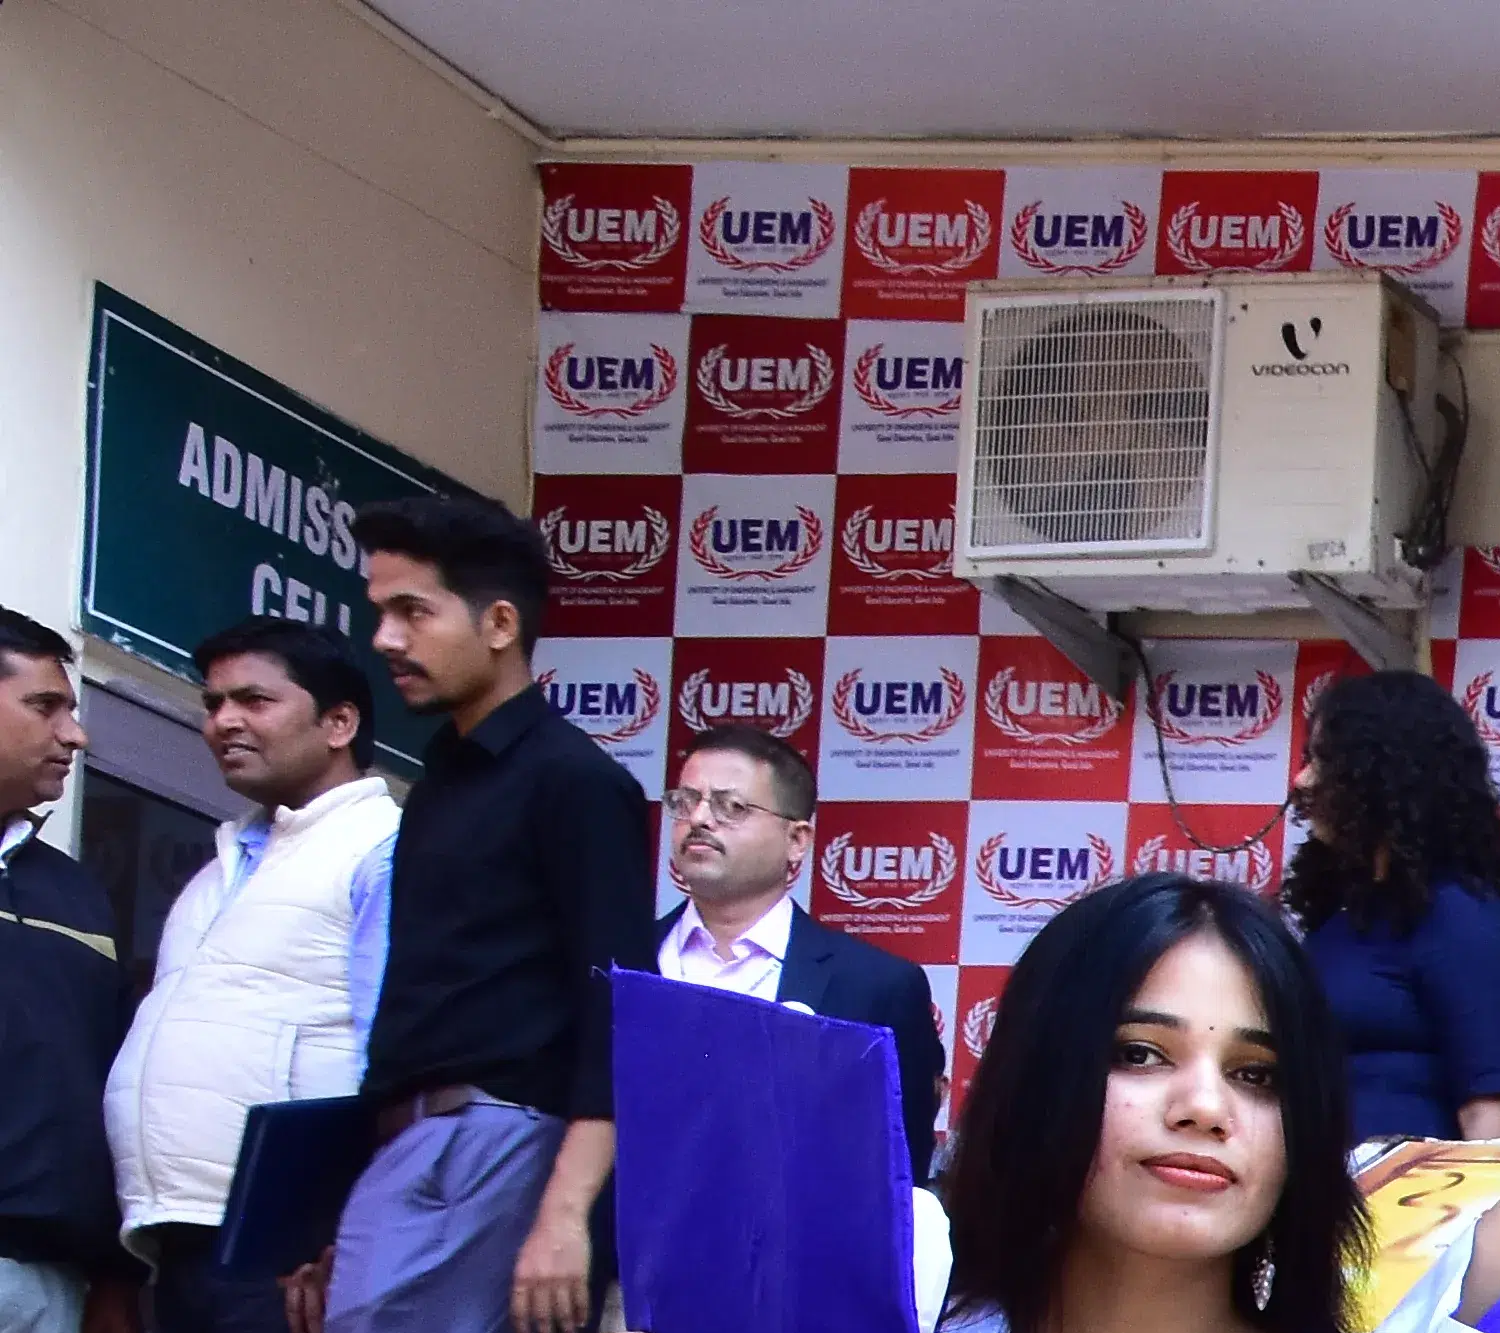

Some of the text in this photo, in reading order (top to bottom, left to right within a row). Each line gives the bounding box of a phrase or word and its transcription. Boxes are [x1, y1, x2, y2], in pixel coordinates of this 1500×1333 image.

[568, 209, 656, 242] UEM
[723, 212, 811, 244] UEM
[878, 214, 968, 246] UEM
[1034, 215, 1123, 247] UEM
[1190, 216, 1280, 248] UEM
[1348, 216, 1438, 249] UEM
[567, 357, 653, 390] UEM
[721, 359, 810, 390] UEM
[877, 358, 962, 390] UEM
[1252, 363, 1349, 376] VIDEOCON
[560, 521, 646, 553] UEM
[712, 519, 799, 553] UEM
[865, 519, 952, 552] UEM
[549, 683, 635, 715] UEM
[702, 683, 789, 716] UEM
[855, 682, 942, 715] UEM
[1009, 683, 1099, 716] UEM
[1167, 685, 1258, 717] UEM
[845, 847, 933, 880] UEM
[999, 848, 1089, 880] UEM
